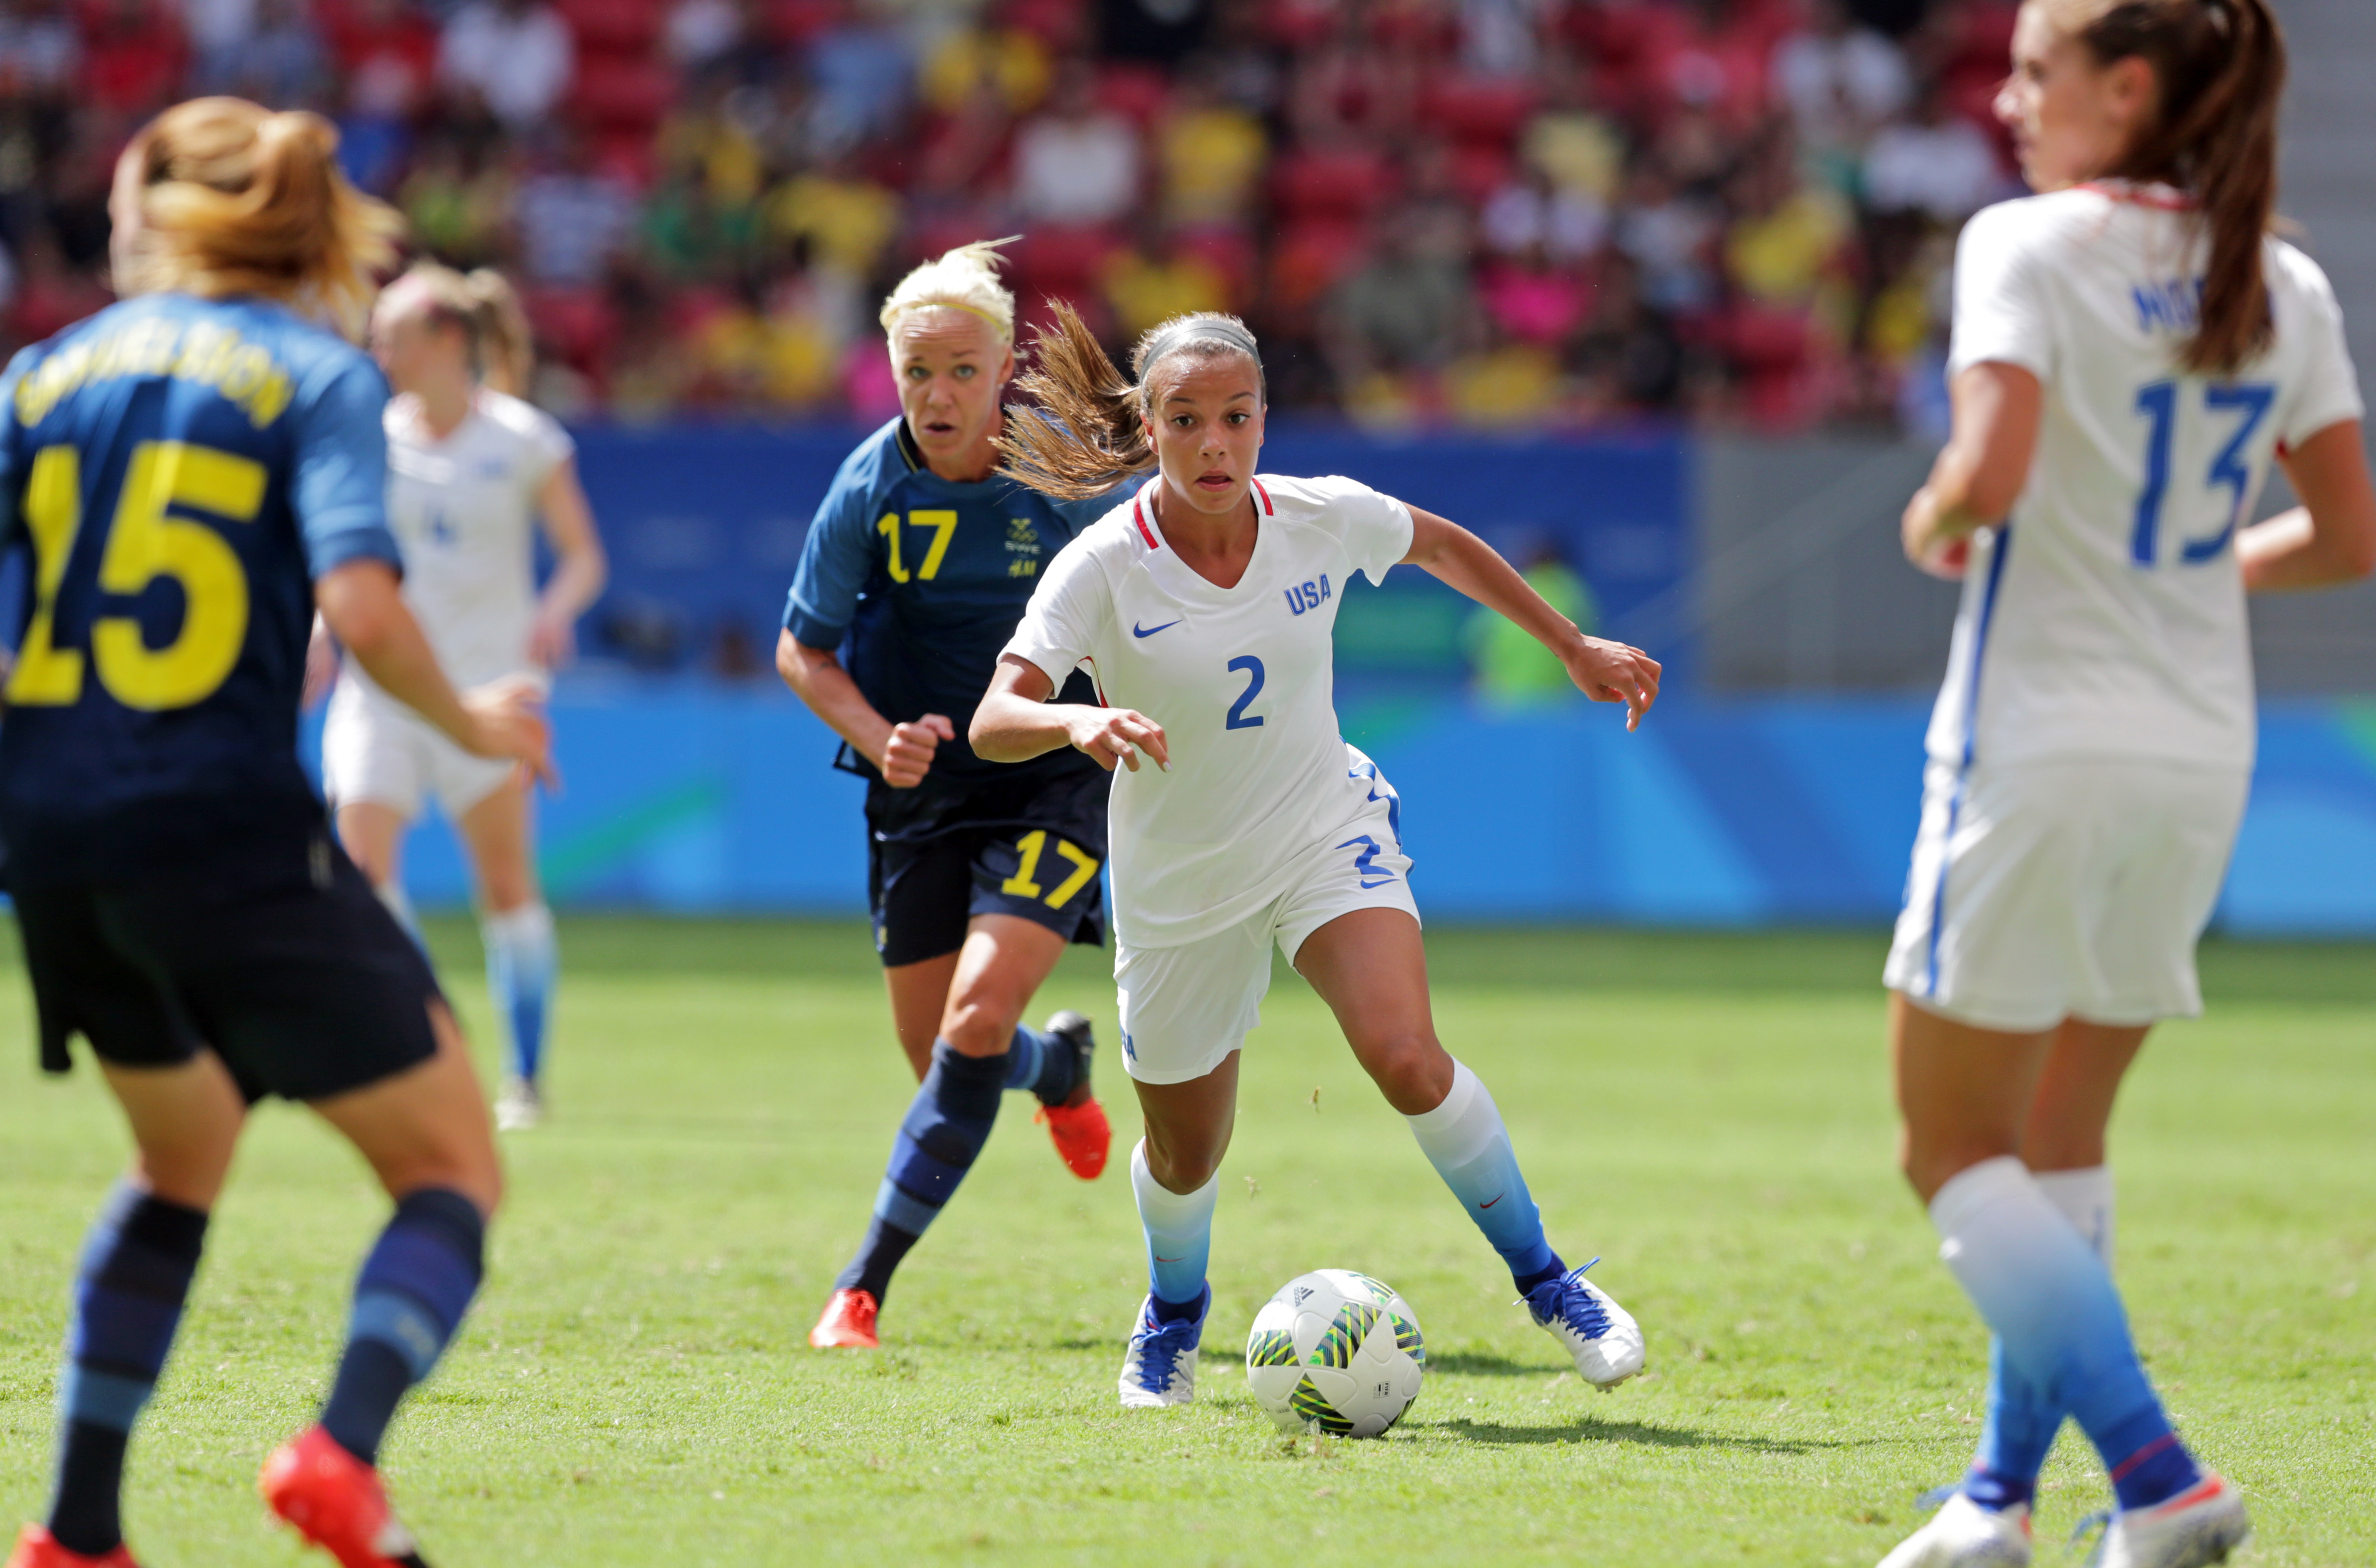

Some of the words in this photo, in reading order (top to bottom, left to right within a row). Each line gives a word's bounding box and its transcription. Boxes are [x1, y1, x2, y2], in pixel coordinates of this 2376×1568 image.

[2130, 380, 2277, 567] 13
[7, 440, 267, 711] 15
[877, 509, 958, 584] 17
[1283, 573, 1331, 616] USA
[1226, 655, 1265, 730] 2
[1001, 830, 1099, 910] 17
[1335, 834, 1395, 876] 2
